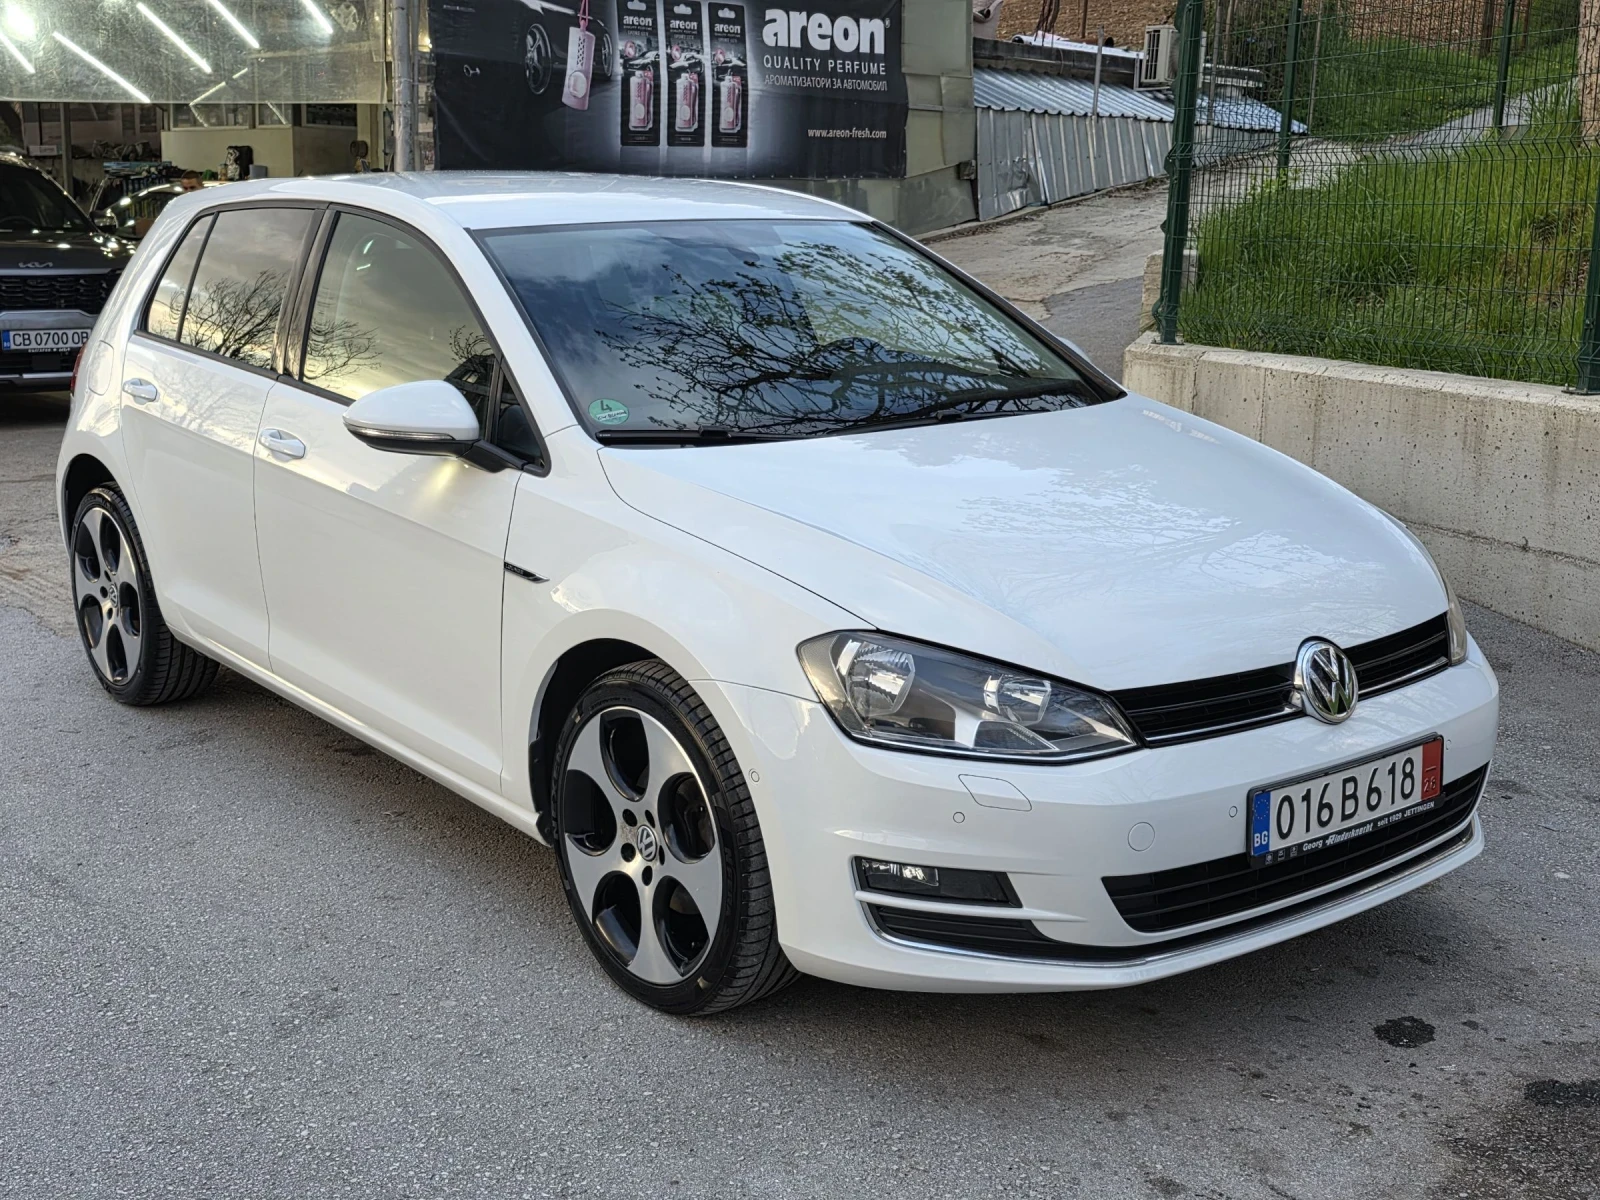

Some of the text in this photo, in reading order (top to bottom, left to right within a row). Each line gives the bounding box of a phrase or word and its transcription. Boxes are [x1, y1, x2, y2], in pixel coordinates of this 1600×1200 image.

[623, 15, 653, 26] areon
[670, 20, 698, 30] areon
[714, 23, 741, 33] areon
[763, 55, 886, 75] QUALITY PERFUME
[764, 75, 887, 91] АРОМАТИЗАТОРИ ЗА АВТОМОБИЛ
[808, 127, 887, 139] www.areon-fresh.com
[13, 333, 31, 347] CB
[35, 331, 69, 346] 0700
[601, 400, 612, 411] 4
[1276, 757, 1415, 840] 016B618
[1302, 840, 1323, 851] Georg
[1404, 800, 1435, 817] JETTINGEN
[1254, 830, 1268, 847] BG
